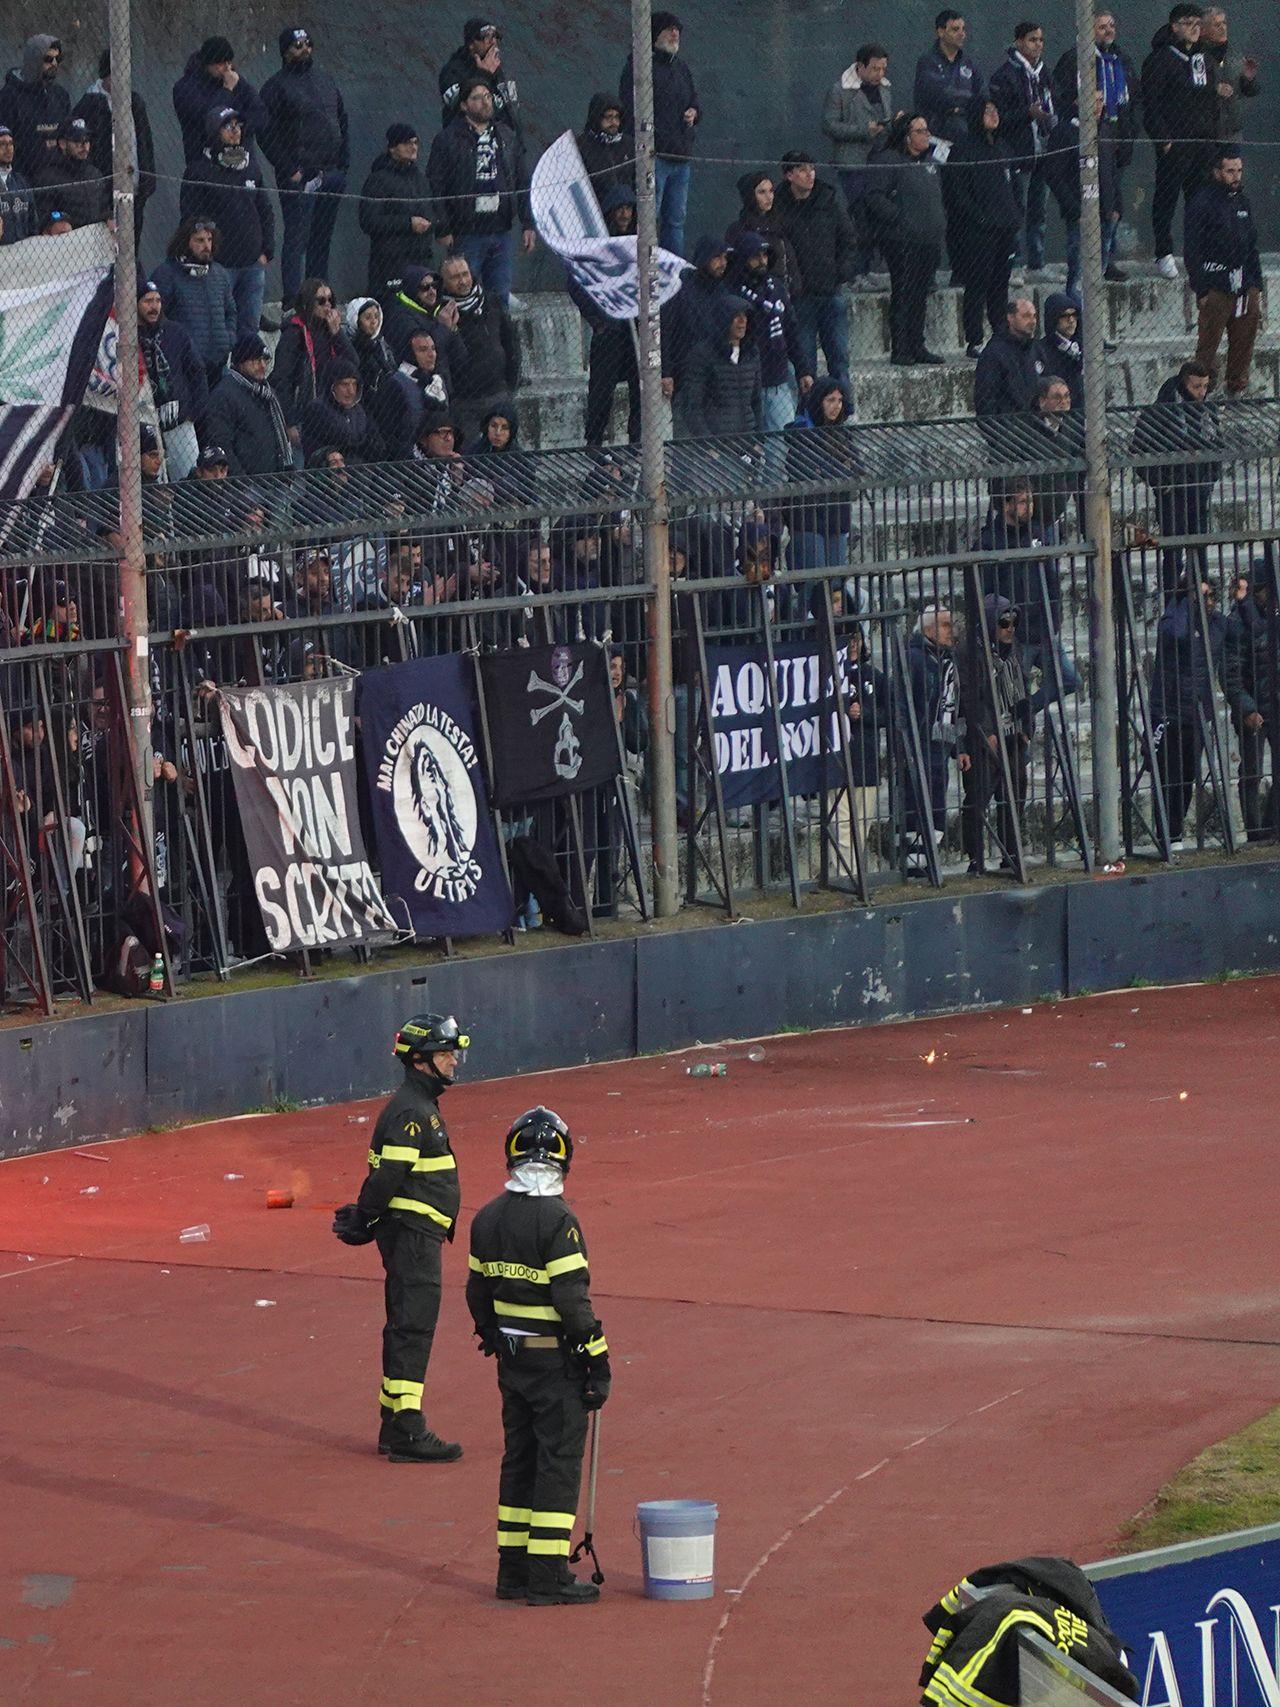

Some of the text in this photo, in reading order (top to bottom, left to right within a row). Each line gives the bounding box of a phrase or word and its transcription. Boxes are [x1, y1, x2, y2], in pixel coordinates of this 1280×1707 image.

[220, 677, 355, 771] CODICE
[377, 702, 479, 792] MAI CHINATO LA TESTA!
[714, 727, 771, 775] DEL
[266, 771, 353, 859] NON
[414, 859, 482, 903] ULTRAS
[504, 1264, 539, 1282] FUOCO
